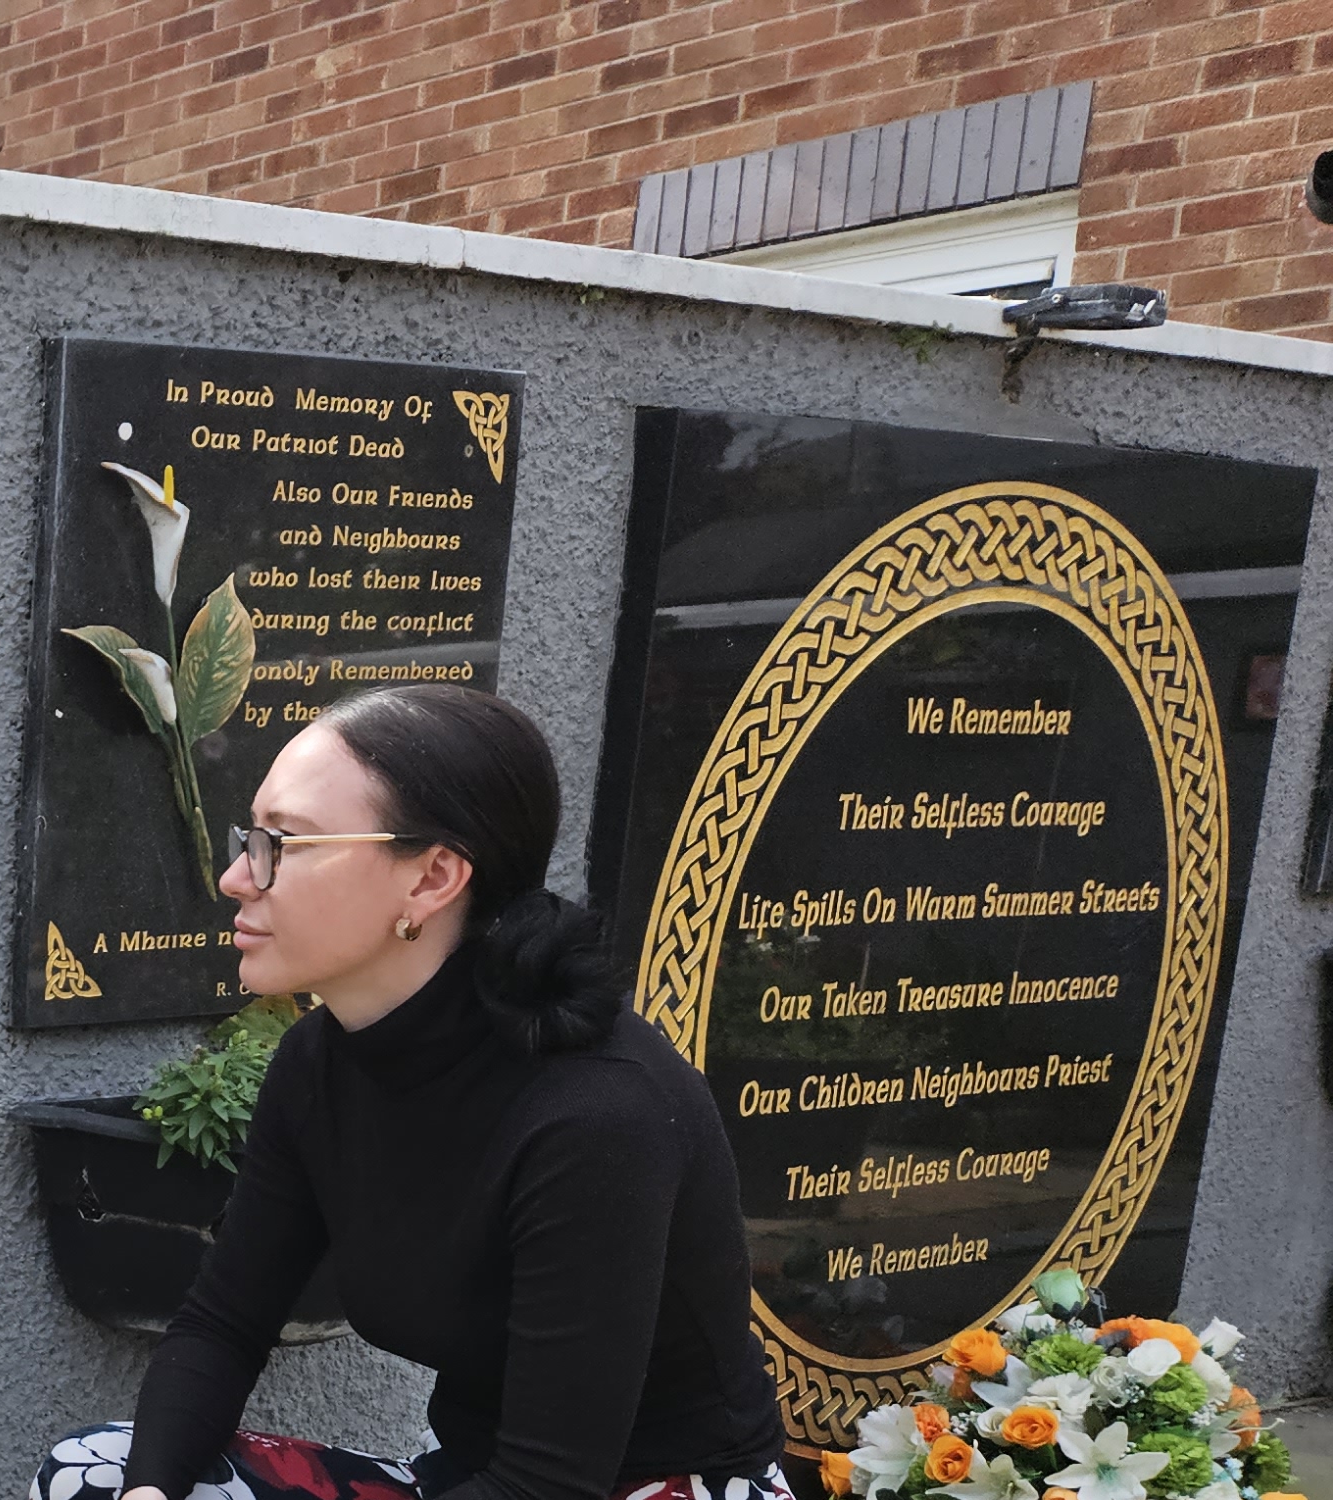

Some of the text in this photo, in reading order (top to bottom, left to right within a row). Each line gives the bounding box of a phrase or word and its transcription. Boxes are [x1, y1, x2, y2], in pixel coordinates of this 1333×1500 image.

[166, 378, 433, 424] In Proud Memory Of
[191, 425, 405, 459] Our Patriot Dead
[272, 479, 474, 510] Also Our Friends
[279, 524, 461, 555] and Neighbours
[248, 566, 482, 592] who lost their lives
[251, 608, 474, 637] during the conflict
[254, 658, 474, 686] ondly Remembered
[244, 700, 273, 729] by
[907, 697, 1072, 736] We Remember
[838, 791, 1106, 840] Their Selfless Courage
[738, 879, 1161, 941] Life Spills On Warm Summer Streets
[93, 932, 108, 954] A
[119, 930, 207, 952] Mhuire
[216, 981, 232, 997] R.
[759, 970, 1120, 1023] Our Taken Treasure Innocence
[739, 1053, 1114, 1118] Our Children Neighbours Priest
[786, 1147, 1051, 1201] Their Selfless Courage
[827, 1232, 989, 1282] We Remember
